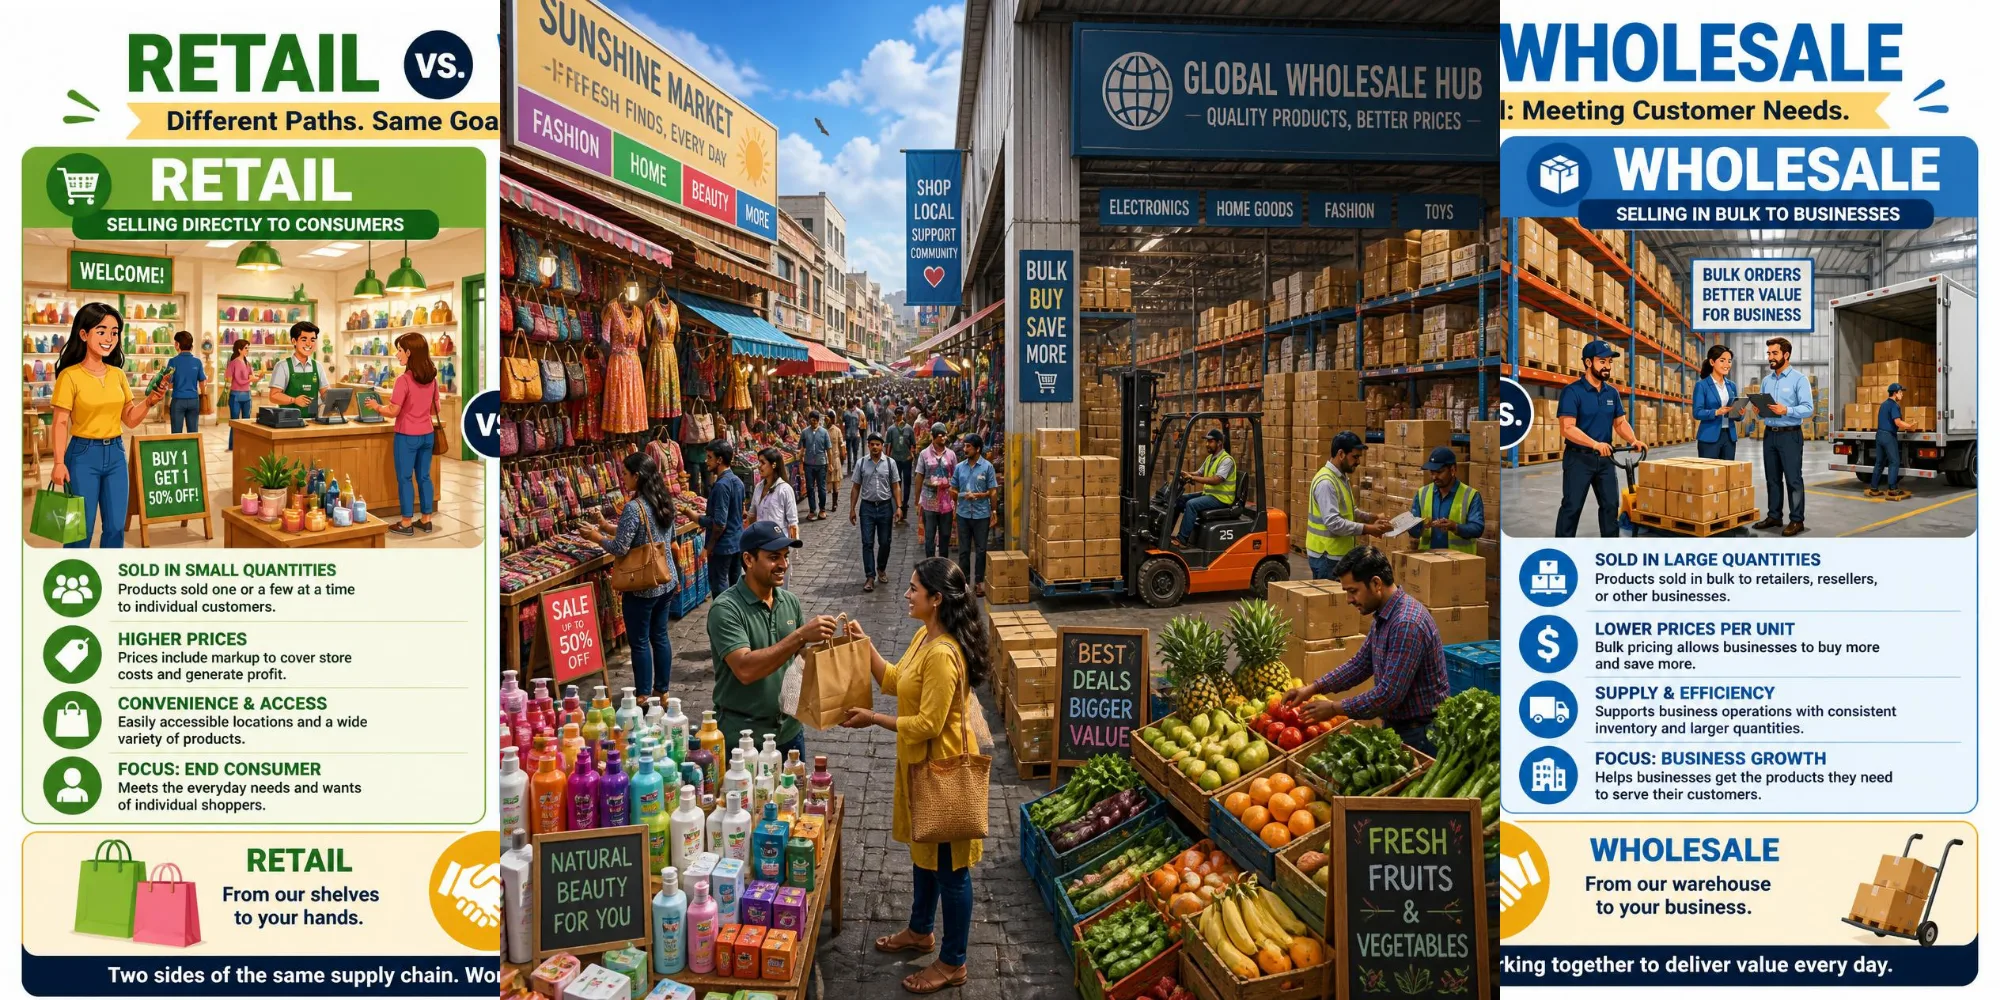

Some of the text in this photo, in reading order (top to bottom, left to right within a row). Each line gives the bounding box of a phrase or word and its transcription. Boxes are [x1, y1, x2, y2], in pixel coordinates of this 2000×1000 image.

[1501, 22, 1903, 83] WHOLESALE
[129, 34, 379, 92] RETAIL
[415, 53, 465, 79] VS.
[539, 0, 734, 138] SUNSHINE MARKET
[1184, 60, 1483, 100] GLOBAL WHOLESALE HUB
[168, 110, 277, 131] Different
[286, 110, 363, 130] Paths.
[373, 111, 442, 131] Same
[1206, 107, 1462, 131] QUALITY PRODUCTS, BETTER PRICES
[1523, 100, 1624, 125] Meeting
[1633, 100, 1755, 120] Customer
[1764, 100, 1849, 120] Needs.
[533, 108, 600, 159] FASHION
[625, 98, 668, 139] FINDS,
[671, 124, 705, 157] EVERY
[708, 150, 728, 169] DAY
[630, 152, 667, 188] HOME
[1613, 147, 1941, 191] WHOLESALE
[151, 158, 353, 202] RETAIL
[916, 179, 952, 197] SHOP
[691, 179, 730, 213] BEAUTY
[745, 203, 770, 230] MORE
[914, 202, 955, 221] LOCAL
[1109, 199, 1190, 217] ELECTRONICS
[1216, 201, 1294, 218] HOME GOODS
[1324, 202, 1375, 219] FASHION
[1425, 204, 1455, 221] TOYS
[1617, 207, 1900, 221] SELLING IN BULK TO BUSINESSES
[107, 217, 404, 231] SELLING DIRECTLY TO CONSUMERS
[911, 227, 957, 243] SUPPORT
[910, 246, 959, 260] COMMUNITY
[80, 262, 164, 284] WELCOME!
[1026, 260, 1067, 281] BULK
[1703, 268, 1801, 281] BULK ORDERS
[1030, 289, 1064, 310] BUY
[1703, 288, 1801, 301] BETTER VALUE
[1703, 308, 1801, 321] FOR BUSINESS
[1026, 317, 1067, 338] SAVE
[1026, 345, 1067, 365] MORE
[152, 450, 187, 466] BUY 1
[155, 469, 188, 485] GET 1
[149, 488, 198, 505] 50% OFF!
[1219, 530, 1234, 540] 25
[1595, 553, 1821, 567] SOLD IN LARGE QUANTITIES
[118, 563, 336, 578] SOLD IN SMALL QUANTITIES
[552, 594, 589, 623] SALE
[562, 621, 585, 633] UP TO
[1596, 622, 1795, 635] LOWER PRICES PER UNIT
[116, 632, 247, 648] HIGHER PRICES
[559, 631, 593, 656] 50%
[568, 652, 590, 669] OFF
[1077, 643, 1127, 665] BEST
[1072, 670, 1131, 690] DEALS
[1596, 686, 1775, 699] SUPPLY & EFFICIENCY
[118, 696, 327, 710] CONVENIENCE & ACCESS
[1069, 697, 1133, 720] BIGGER
[118, 732, 245, 747] variety of products.
[1069, 724, 1130, 748] VALUE
[1596, 722, 1803, 737] inventory and larger quantities.
[1596, 752, 1826, 765] FOCUS: BUSINESS GROWTH
[119, 762, 321, 776] FOCUS: END CONSUMER
[118, 798, 265, 814] of individual shoppers.
[1369, 827, 1447, 856] FRESH
[1589, 836, 1779, 864] WHOLESALE
[248, 848, 352, 872] RETAIL
[551, 847, 632, 873] NATURAL
[1368, 864, 1454, 892] FRUITS
[1586, 875, 1771, 891] From our warehouse
[223, 886, 379, 902] From our shelves
[557, 877, 628, 904] BEAUTY
[1402, 900, 1420, 924] &
[1596, 898, 1751, 918] to your business.
[234, 909, 363, 929] to your hands.
[554, 905, 632, 935] FOR YOU
[1356, 932, 1469, 958] VEGETABLES
[1551, 955, 1634, 977] together
[1640, 957, 1659, 972] to
[1665, 955, 1731, 973] deliver
[1736, 955, 1788, 973] value
[1794, 960, 1848, 977] every
[1853, 955, 1892, 977] day.
[108, 967, 148, 983] Two
[154, 966, 205, 983] sides
[211, 966, 231, 983] of
[236, 966, 267, 983] the
[273, 970, 325, 983] same
[331, 966, 395, 987] supply
[401, 966, 458, 983] chain.
